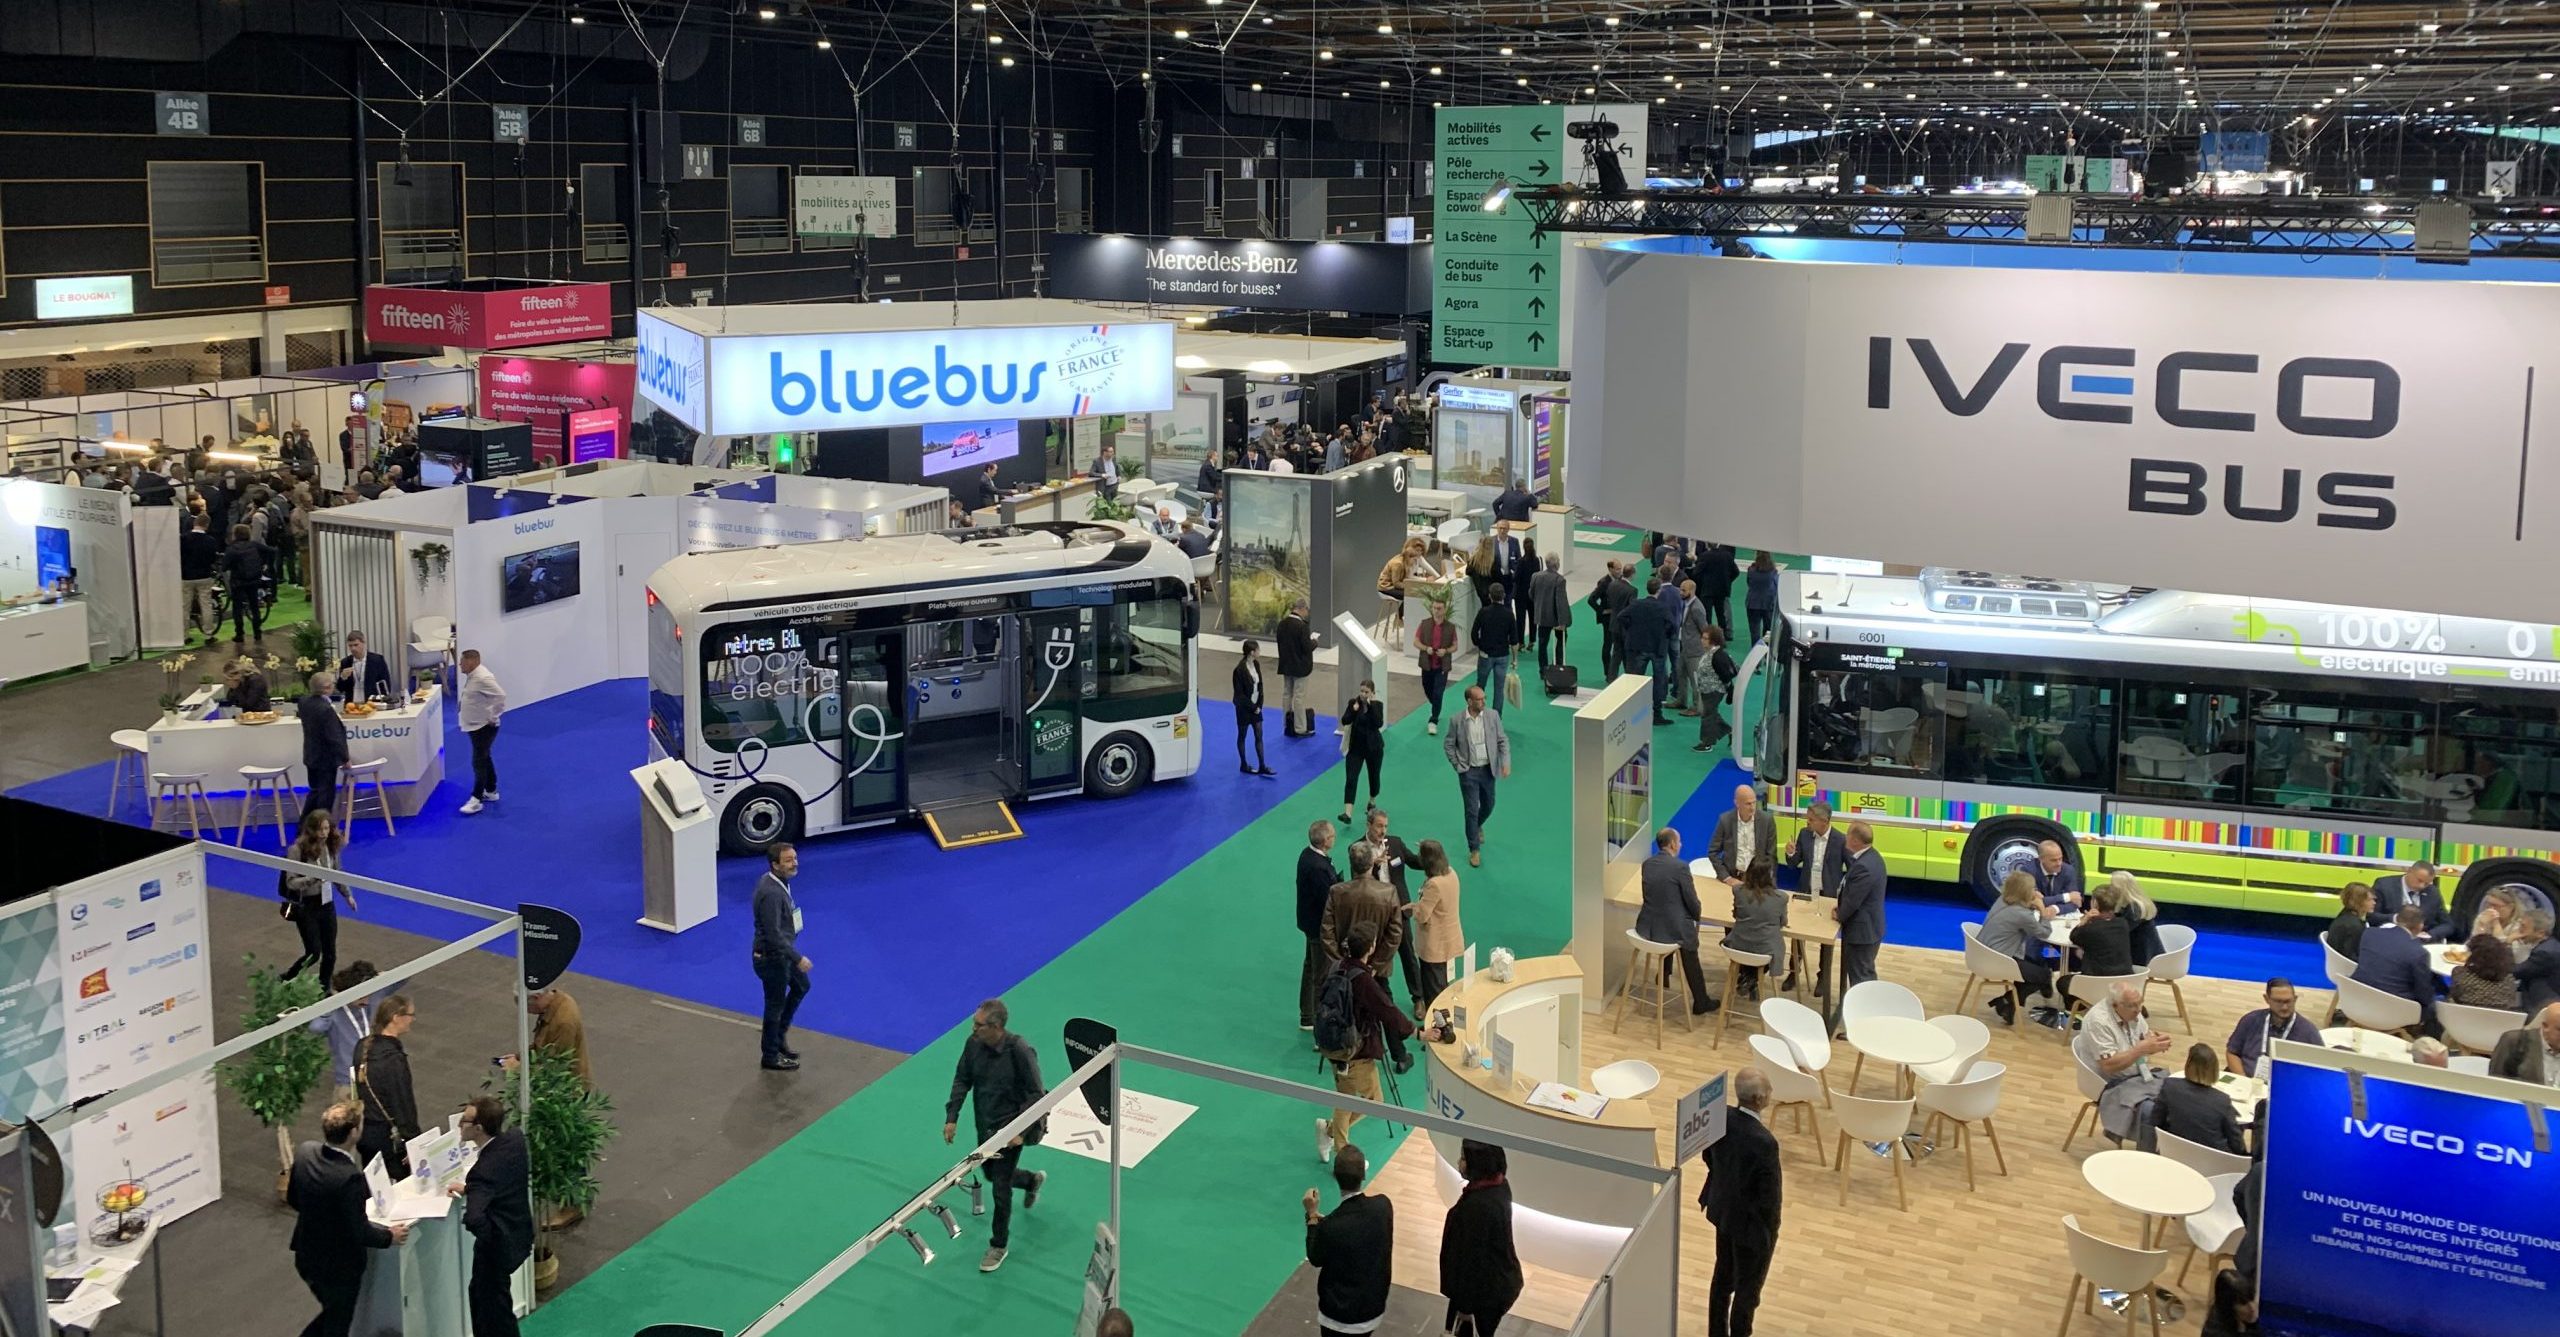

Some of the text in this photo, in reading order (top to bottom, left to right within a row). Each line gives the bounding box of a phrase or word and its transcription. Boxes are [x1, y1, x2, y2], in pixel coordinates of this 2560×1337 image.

[166, 98, 199, 110] Allée
[167, 112, 198, 130] 4B
[1447, 122, 1501, 134] Mobilités
[499, 122, 522, 137] 5B
[744, 130, 760, 142] 6B
[899, 135, 912, 146] 7B
[1447, 134, 1489, 146] actives
[1446, 156, 1472, 168] Pôle
[1446, 168, 1505, 180] recherche
[801, 197, 850, 209] mobilités
[1446, 190, 1486, 202] Espace
[1445, 231, 1497, 242] La Scène
[1146, 248, 1298, 274] Mercedes-Benz
[1445, 259, 1499, 271] Conduite
[1444, 272, 1482, 282] de bus
[1147, 278, 1167, 292] The
[1170, 280, 1219, 293] standard
[1222, 280, 1238, 293] for
[53, 292, 117, 303] LE BOUGNAT
[520, 295, 563, 312] fifteen
[1444, 298, 1479, 310] Agora
[381, 304, 445, 330] fifteen
[510, 320, 525, 328] Faire
[536, 318, 549, 327] vélo
[550, 318, 562, 326] une
[494, 332, 506, 341] des
[1444, 325, 1485, 339] Espace
[1065, 335, 1108, 356] ORIGINE
[1444, 337, 1493, 351] Start-up
[638, 326, 687, 406] bluebus
[1058, 350, 1121, 377] FRANCE
[491, 370, 522, 384] fifteen
[770, 345, 1047, 416] bluebus
[1867, 336, 2401, 439] IVECO
[492, 390, 508, 399] Faire
[509, 390, 519, 400] du
[520, 391, 535, 401] vélo
[536, 394, 550, 402] une
[2128, 458, 2397, 531] BUS
[66, 510, 77, 520] ET
[79, 512, 116, 526] DURABLE
[514, 518, 555, 535] bluebus
[1078, 580, 1152, 594] Technologie modulable
[754, 600, 859, 618] véhicule 100% électrique
[928, 596, 998, 610] Plate-forme ouverte
[789, 614, 832, 626] Accès facile
[1859, 632, 1886, 644] 6001
[2318, 613, 2537, 658] 100% 0
[731, 649, 810, 676] 100%
[1840, 654, 1896, 664] SAINT-ÉTIENNE
[1858, 662, 1896, 670] métropole
[346, 724, 411, 740] bluebus
[1036, 726, 1072, 744] FRANCE
[1860, 794, 1886, 808] stas
[524, 922, 550, 931] Trans-
[524, 930, 559, 940] Missions
[528, 976, 538, 984] 2c
[78, 1018, 126, 1044] SYTRAL
[1099, 1106, 1109, 1118] 3c
[1683, 1110, 1710, 1140] abc
[2344, 1116, 2532, 1168] IVECO ON
[2302, 1190, 2560, 1251] UN NOUVEAU MONDE DE SOLUTIONS
[2342, 1213, 2519, 1258] ET DE SERVICES INTÉGRÉS
[2332, 1227, 2527, 1275] POUR NOS GAMMES DE VÉHICULES
[2312, 1234, 2546, 1290] URBAINS, INTERURBAINS ET DE TOURISME
